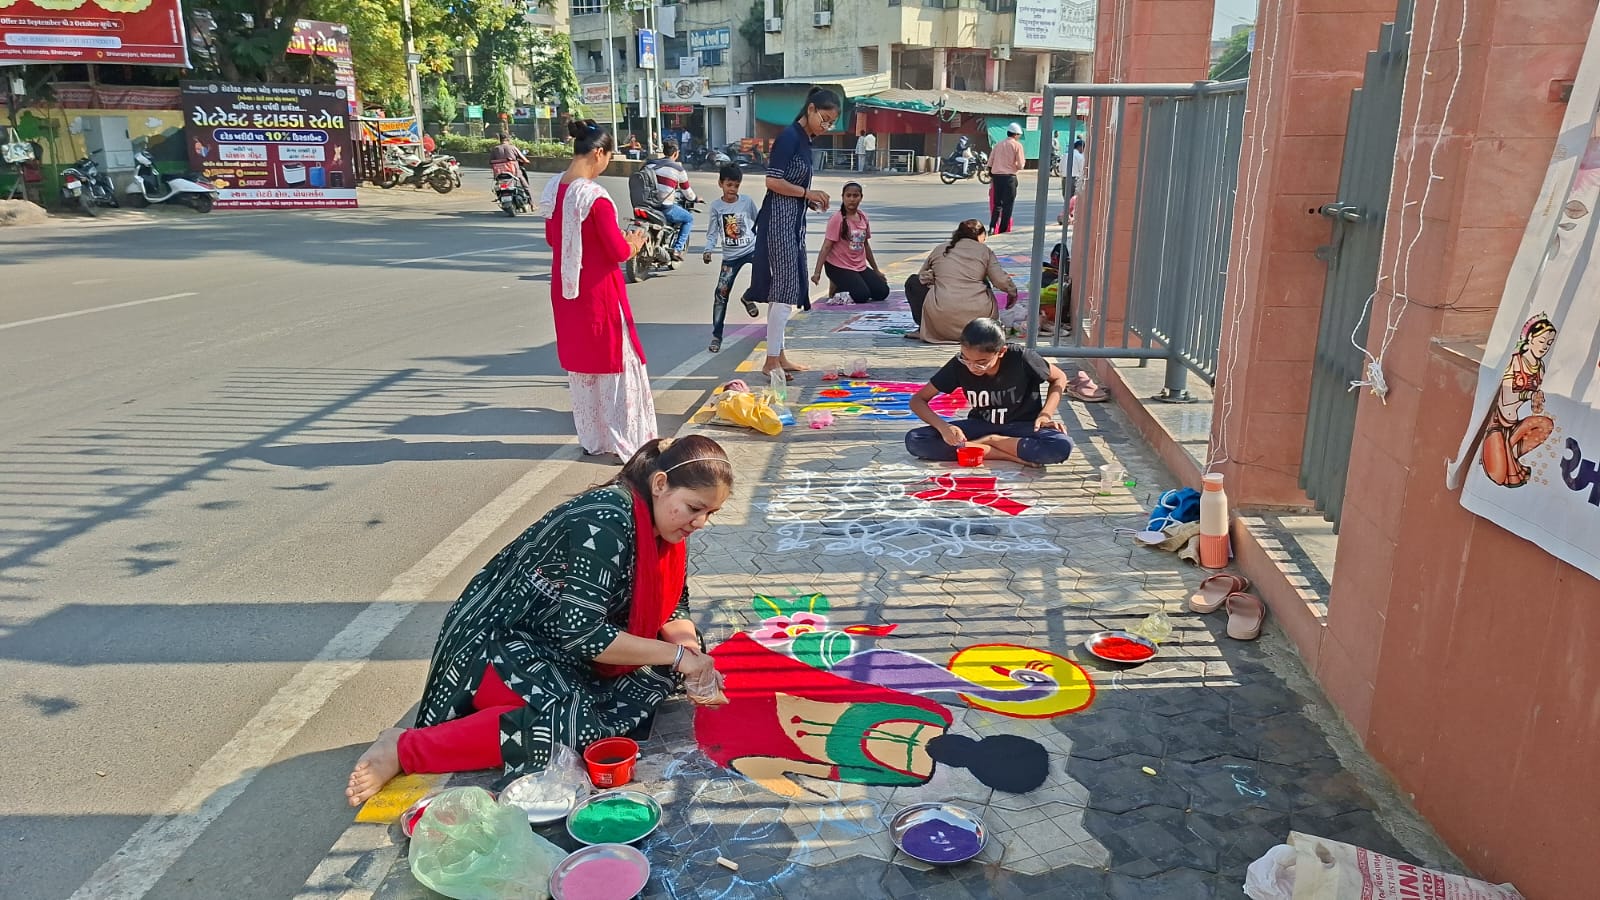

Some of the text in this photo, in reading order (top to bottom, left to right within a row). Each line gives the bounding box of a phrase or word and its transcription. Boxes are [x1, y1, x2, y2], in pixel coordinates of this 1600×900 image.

[27, 19, 61, 27] September
[253, 113, 304, 129] ફટાકડા
[308, 109, 345, 129] સ્ટોલ
